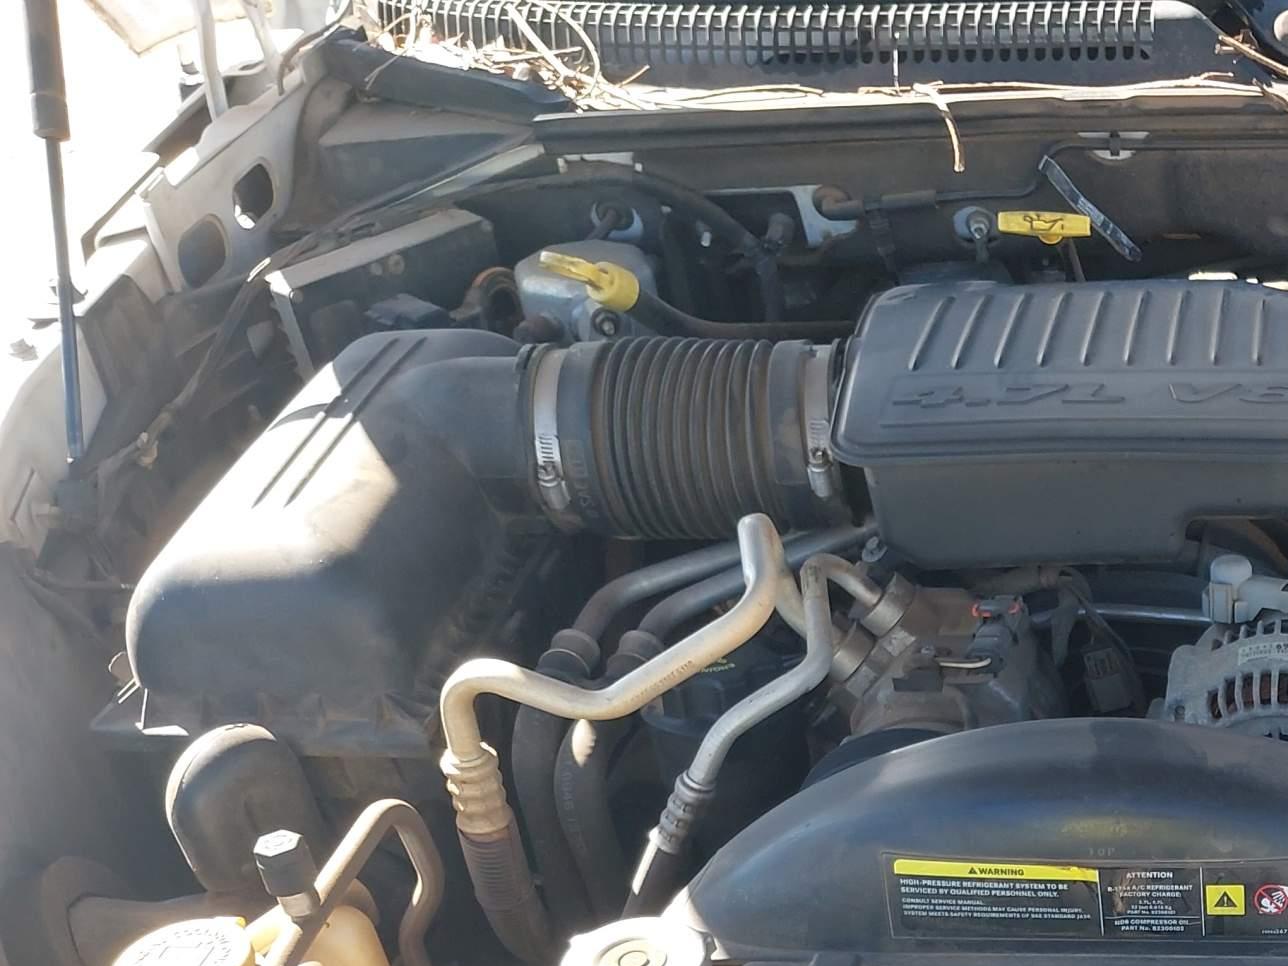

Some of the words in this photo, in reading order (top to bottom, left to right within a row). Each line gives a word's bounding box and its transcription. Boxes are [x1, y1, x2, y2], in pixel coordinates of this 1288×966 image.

[978, 867, 1025, 877] WARNING
[1126, 871, 1174, 879] ATTENTION
[900, 878, 961, 888] HIGH-PRESSURE
[962, 881, 1014, 889] REFRIGERANT
[1131, 884, 1145, 892] A/C
[901, 886, 938, 894] SERVICED
[950, 888, 990, 896] QUALIFIED
